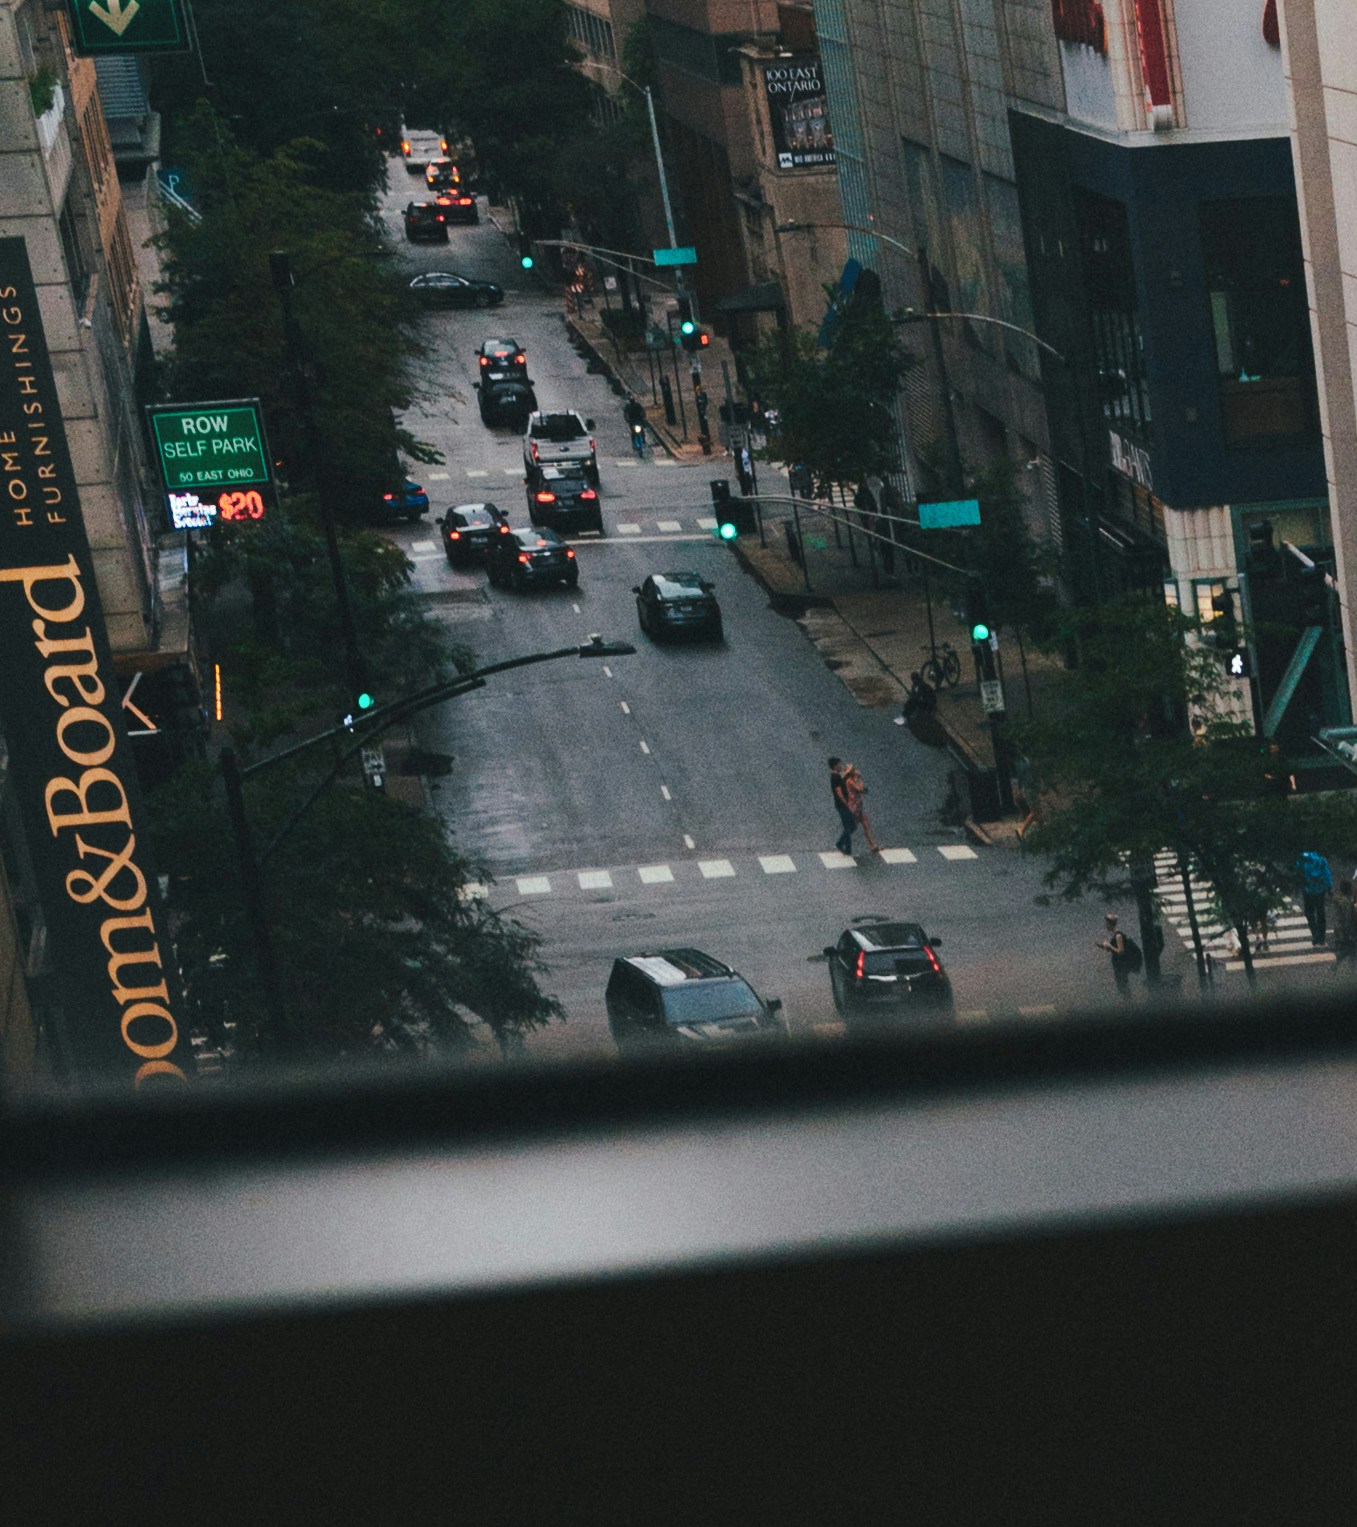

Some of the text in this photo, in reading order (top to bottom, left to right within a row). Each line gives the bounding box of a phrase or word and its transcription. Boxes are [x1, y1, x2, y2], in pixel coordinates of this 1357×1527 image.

[789, 67, 816, 80] EAST
[768, 80, 820, 100] ONTARIO
[0, 286, 66, 523] FURNISHINGS
[181, 415, 228, 435] ROW
[164, 437, 258, 459] SELF PARK
[0, 431, 33, 526] HOME
[179, 468, 254, 482] 50 EAST OHIO
[219, 491, 264, 520] $20
